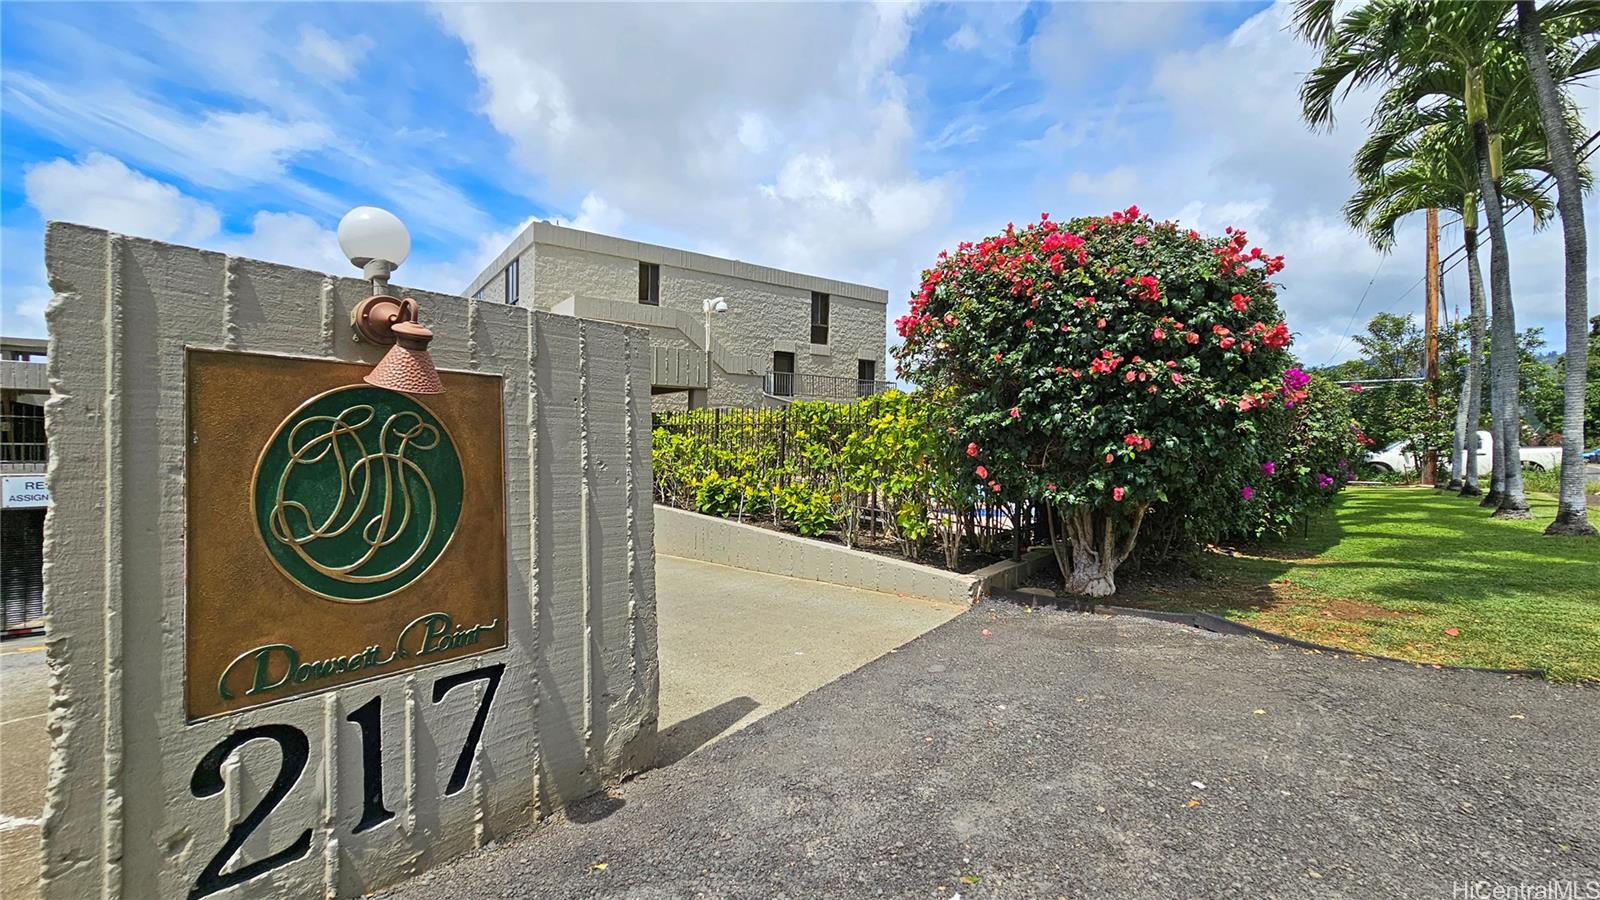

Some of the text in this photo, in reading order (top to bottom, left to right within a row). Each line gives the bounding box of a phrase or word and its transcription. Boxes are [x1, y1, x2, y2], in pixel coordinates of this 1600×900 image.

[25, 481, 48, 490] RE
[218, 611, 498, 700] Dowsett Point
[187, 663, 506, 900] 217
